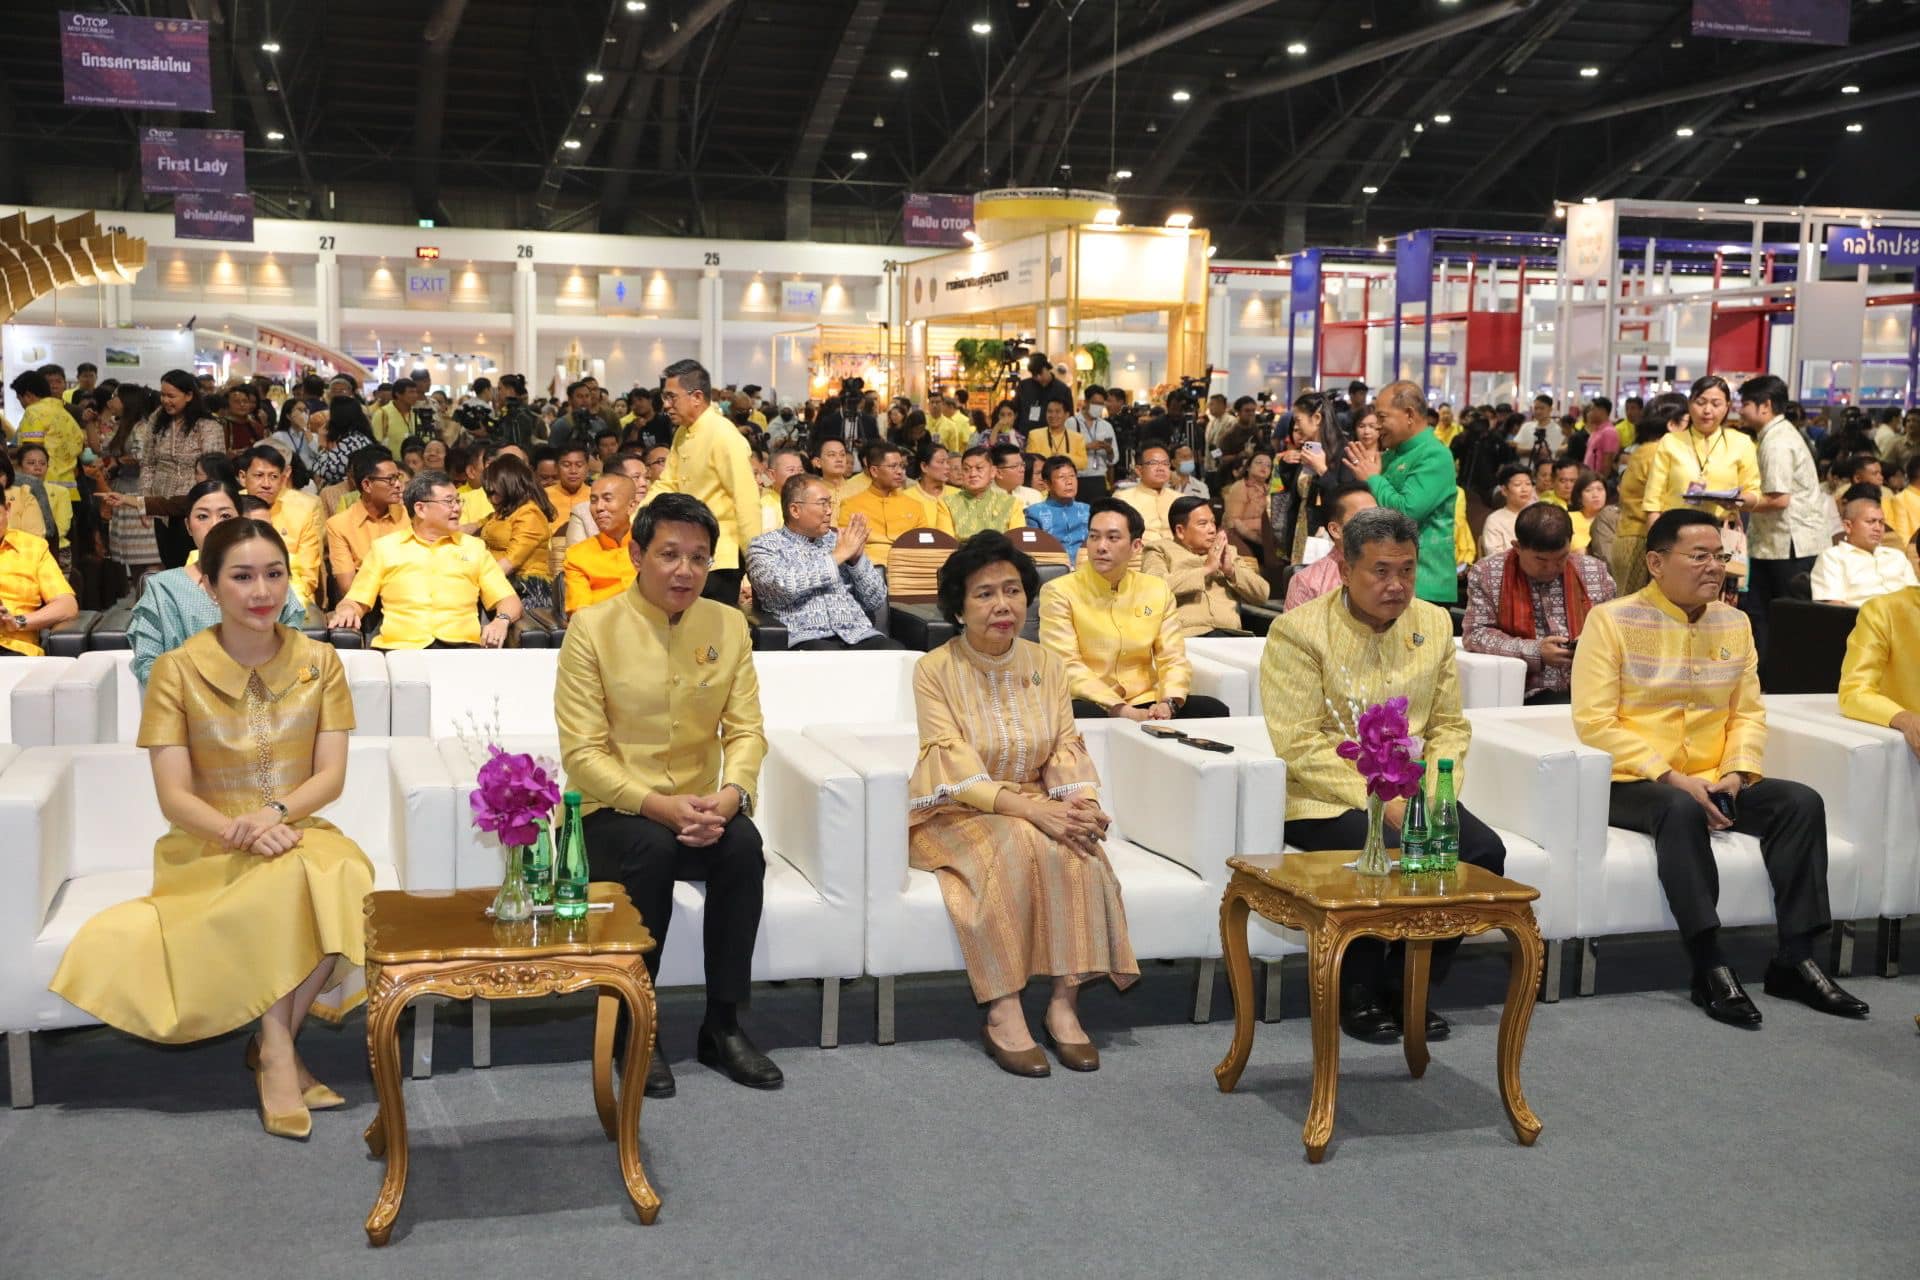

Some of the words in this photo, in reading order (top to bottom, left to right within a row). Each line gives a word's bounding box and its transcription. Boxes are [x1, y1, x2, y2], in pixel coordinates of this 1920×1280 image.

[81, 52, 191, 73] นิทรรศการเส้นไหม
[157, 156, 191, 172] First
[194, 158, 228, 176] Lady
[941, 217, 971, 230] OTOP
[319, 236, 336, 250] 27
[517, 244, 534, 258] 26
[704, 252, 720, 266] 25
[410, 275, 446, 292] EXIT
